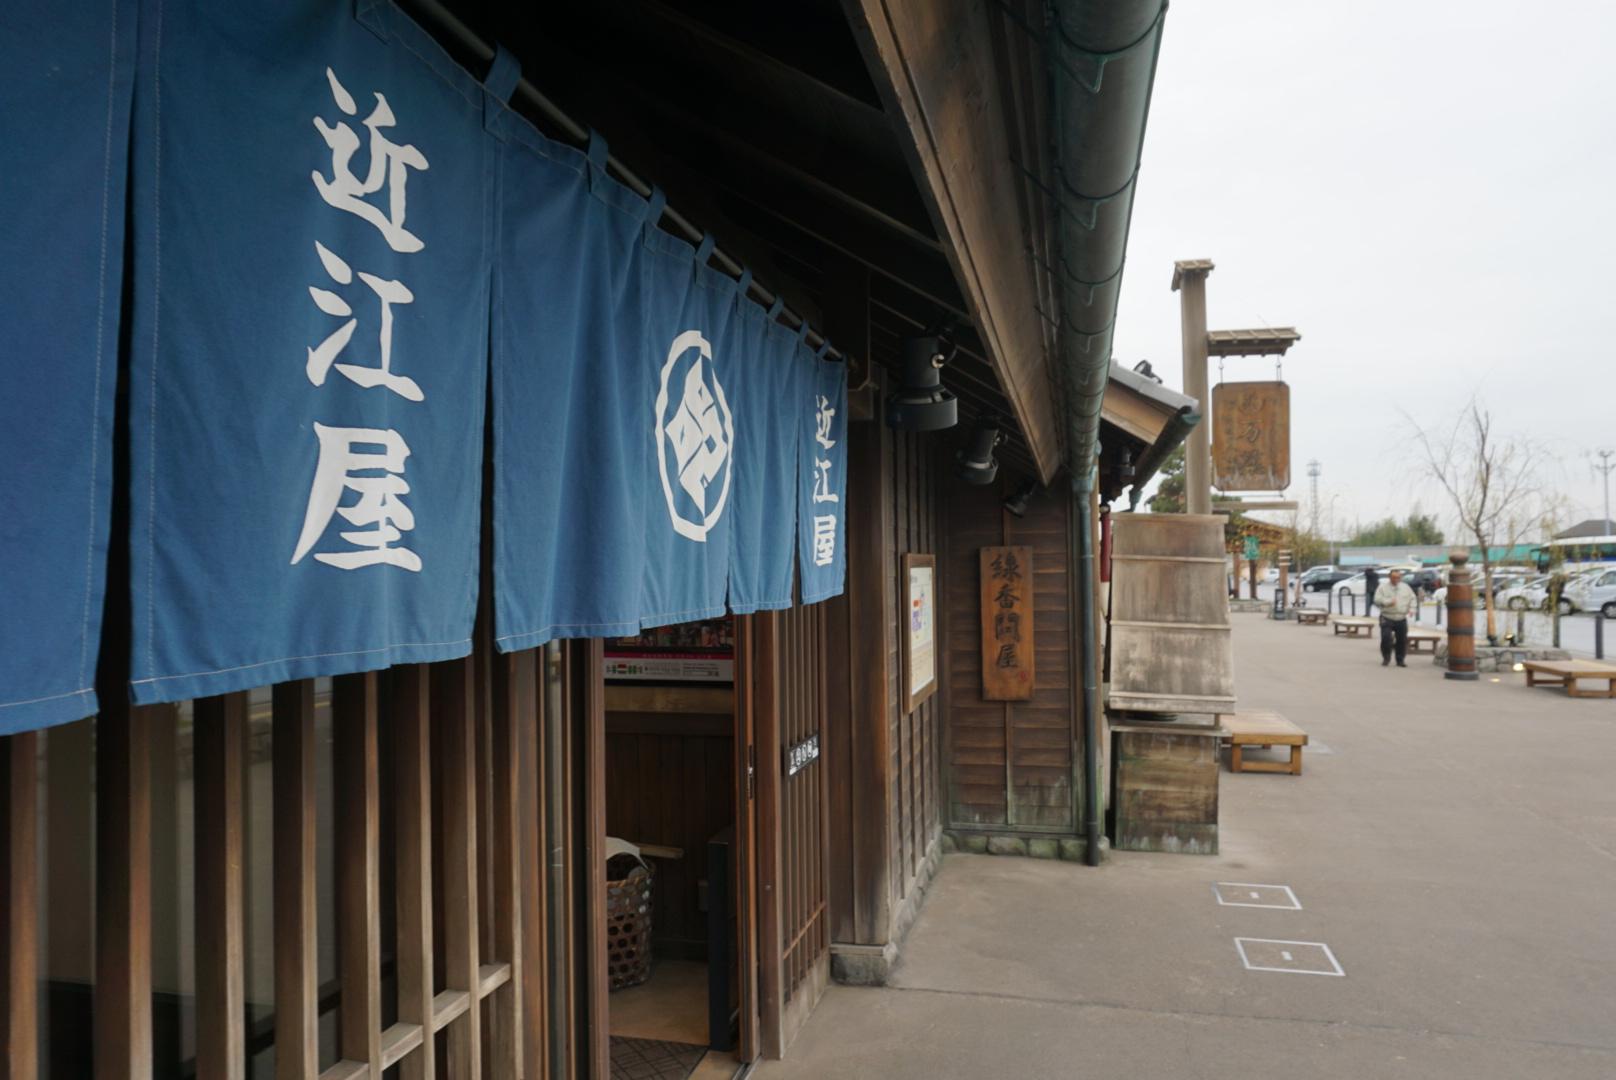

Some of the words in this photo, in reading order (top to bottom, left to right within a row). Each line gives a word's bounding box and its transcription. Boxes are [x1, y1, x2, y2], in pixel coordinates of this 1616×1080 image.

[290, 66, 429, 573] 近江屋
[812, 394, 839, 567] 近江屋
[990, 551, 1023, 668] 線香問屋
